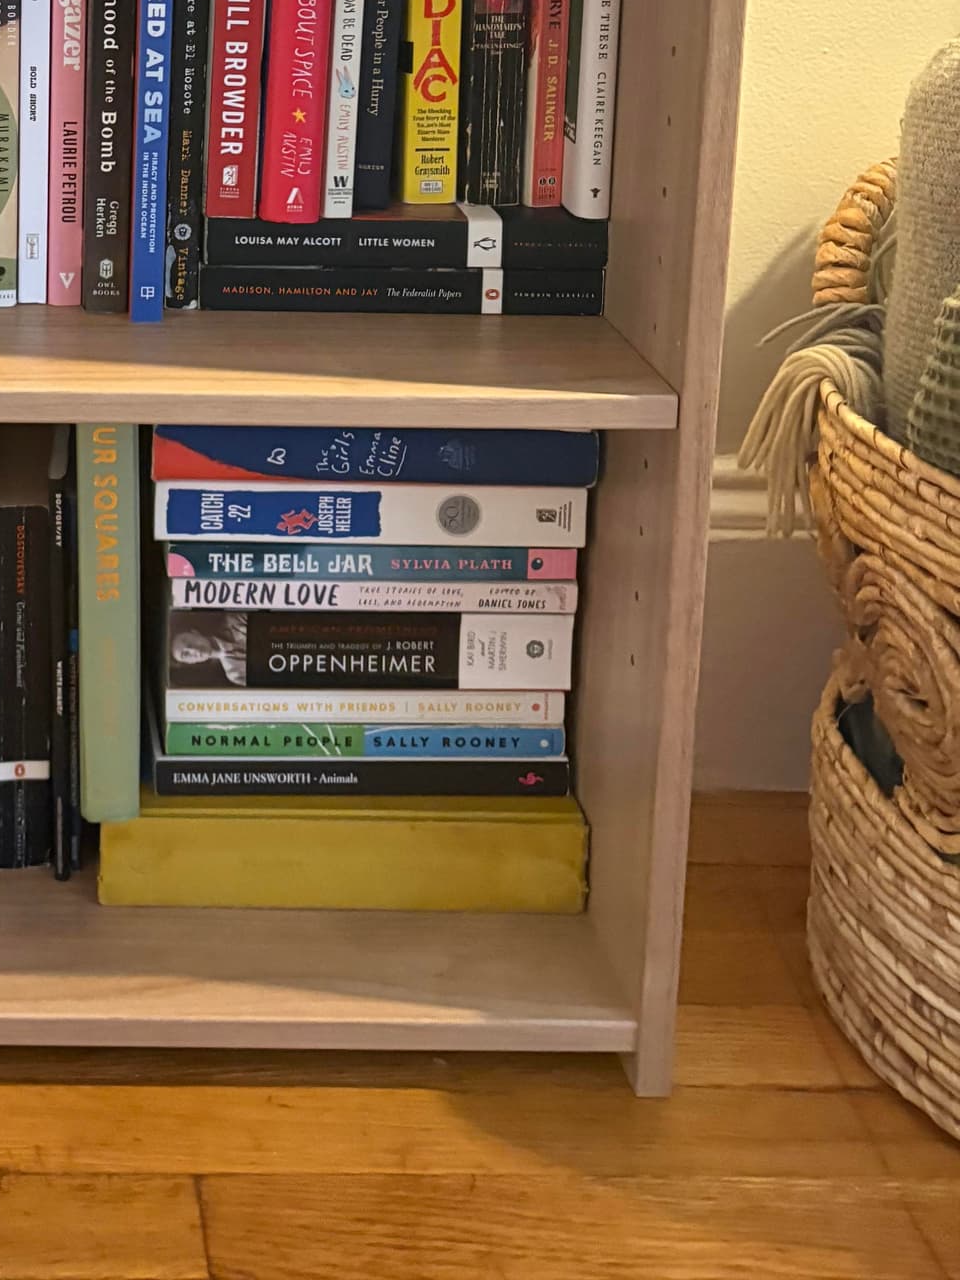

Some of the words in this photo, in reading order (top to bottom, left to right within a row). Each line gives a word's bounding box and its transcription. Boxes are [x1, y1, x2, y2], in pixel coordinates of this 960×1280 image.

[597, 13, 611, 60] THESE
[145, 49, 165, 82] AT
[292, 49, 315, 98] SPACE
[221, 41, 248, 154] BROWDER
[596, 72, 606, 114] CLAIRE
[144, 90, 163, 144] SEA
[63, 121, 77, 168] LAURIE
[593, 119, 603, 165] KEEGAN
[415, 166, 450, 178] Graysmith
[421, 155, 444, 164] Robert
[63, 173, 77, 223] PETROU
[235, 236, 273, 245] LOUISA
[277, 237, 300, 245] MAY
[303, 237, 341, 245] ALCOTT
[358, 238, 389, 246] LITTLE
[392, 239, 435, 247] WOMEN
[201, 493, 224, 530] CATCH
[319, 496, 334, 533] JOSEPH
[336, 498, 351, 532] HELLER
[94, 474, 119, 601] SQUARES
[209, 553, 254, 572] THE
[264, 554, 319, 573] BELL
[328, 555, 373, 576] JAR
[391, 560, 450, 569] SYLVIA
[458, 560, 512, 570] PLATH
[185, 581, 275, 604] MODERN
[284, 583, 339, 606] LOVE
[268, 654, 436, 673] OPPENHEIMER
[192, 736, 271, 746] NORMAL
[284, 736, 352, 747] PEOPLE
[374, 737, 430, 747] SALLY
[443, 737, 521, 748] ROONEY
[173, 773, 209, 784] EMMA
[211, 773, 240, 785] JANE
[244, 773, 311, 784] UNSWORTH
[319, 773, 358, 784] Animals
